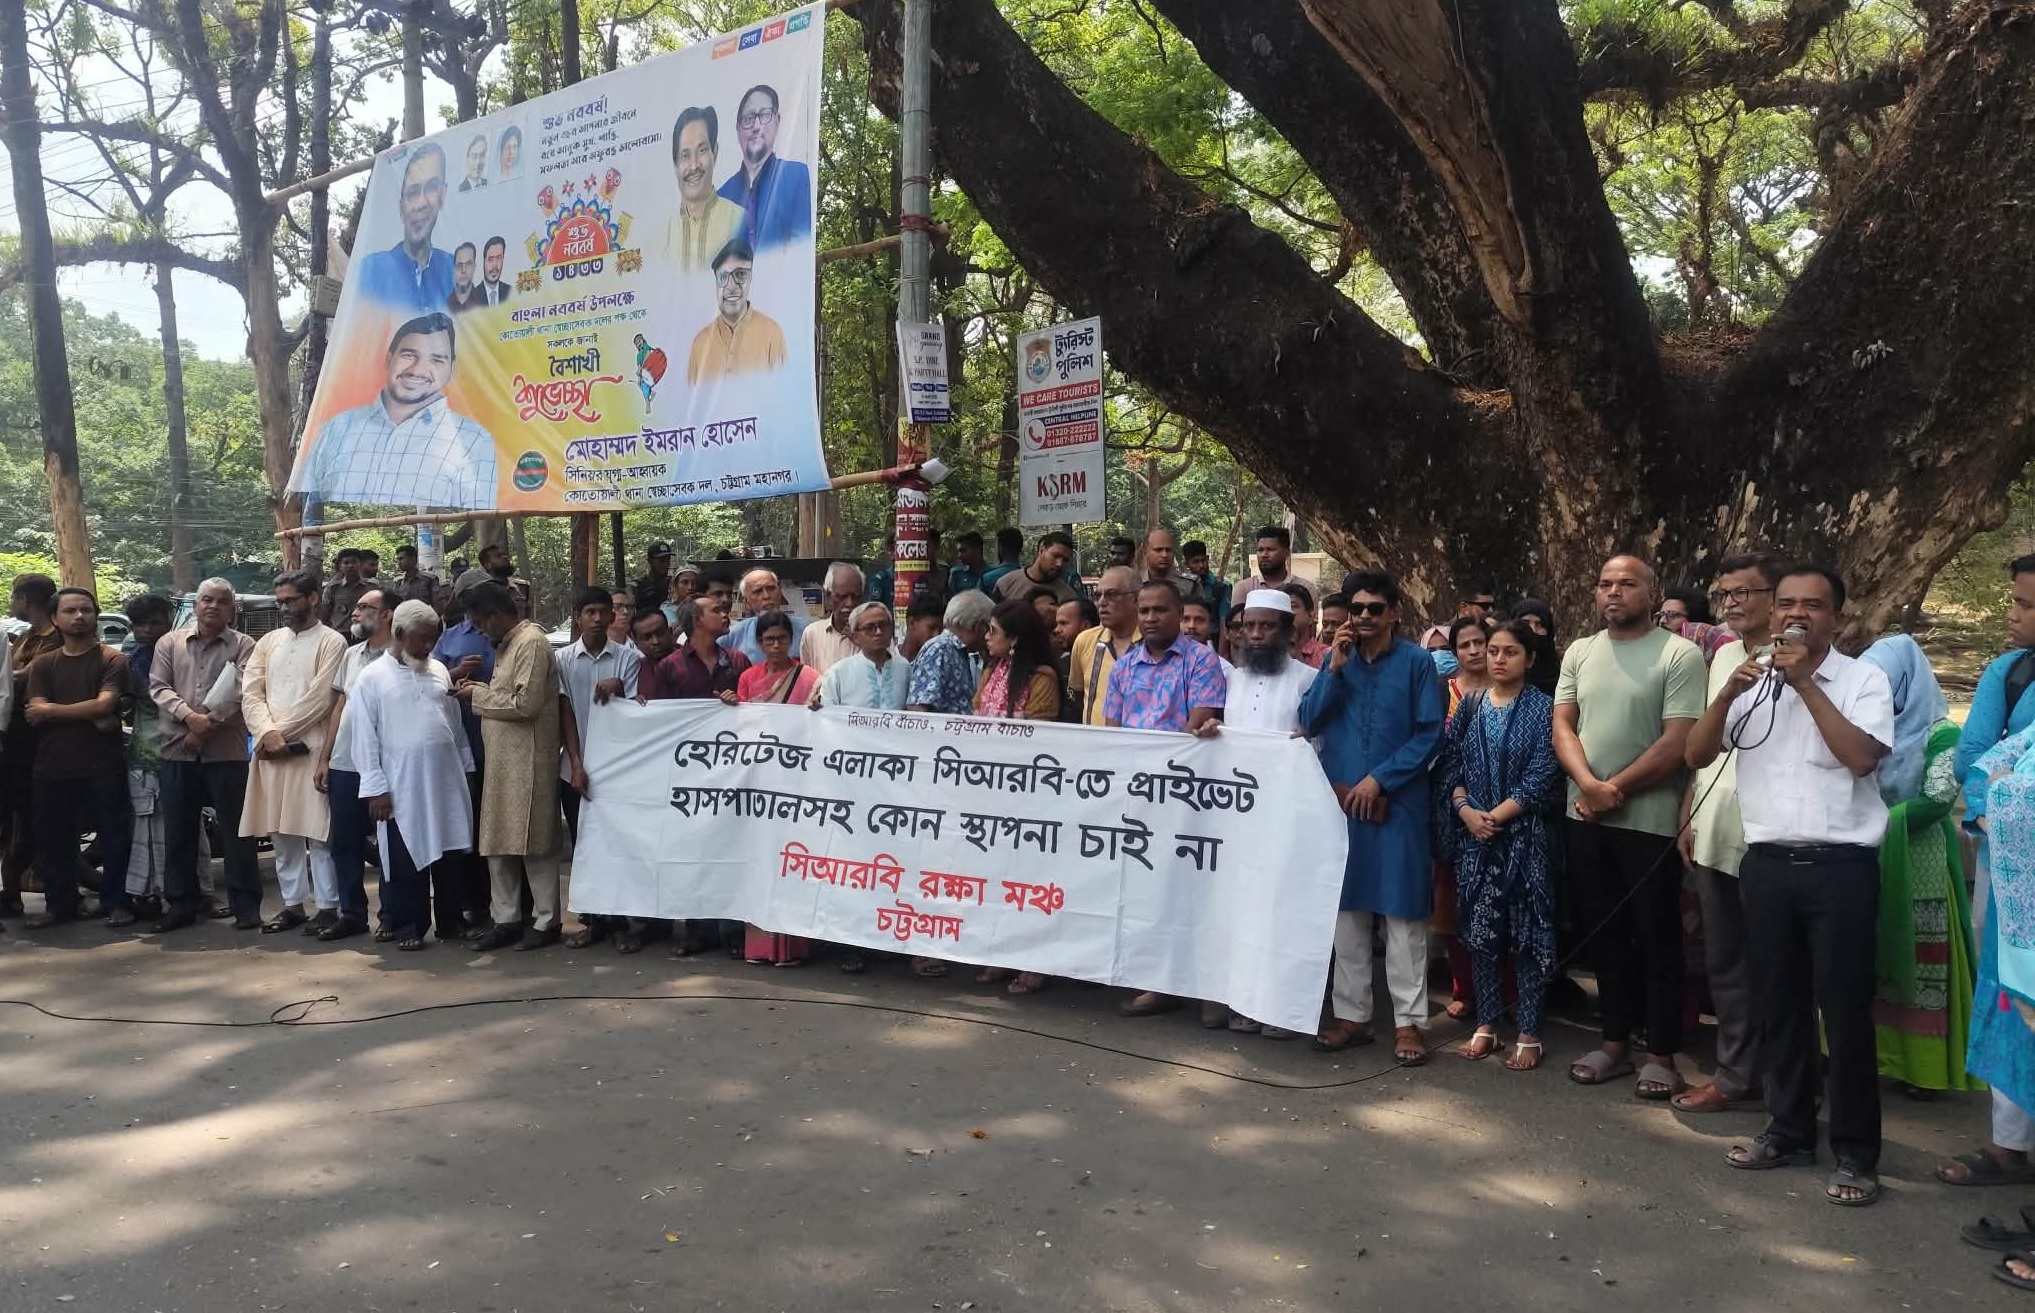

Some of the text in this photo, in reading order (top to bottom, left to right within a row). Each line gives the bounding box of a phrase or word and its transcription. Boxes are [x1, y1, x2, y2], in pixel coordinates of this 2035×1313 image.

[563, 232, 595, 257] নববর্ষ
[567, 223, 590, 240] শুভ
[554, 258, 603, 281] ১৪৩৩
[511, 291, 635, 323] বাংলা নববর্ষ উপলক্ষে
[547, 333, 598, 349] সকলকে জানাই
[1055, 327, 1094, 357] ট্যুরিস্ট
[548, 348, 601, 377] বৈশাখী
[1055, 353, 1094, 379] পুলিশ
[513, 374, 624, 423] শুভেচ্ছা
[1023, 383, 1098, 405] WE CARE TOURISTS
[566, 416, 757, 463] মোহাম্মদ ইমরান হোসেন
[564, 466, 602, 483] সিনিয়র
[564, 486, 622, 502] কোতোয়ালী
[625, 486, 644, 500] থানা
[647, 481, 695, 500] স্বেচ্ছাসেবক
[720, 474, 751, 491] চট্টগ্রাম
[1037, 470, 1087, 500] KSRM
[896, 540, 928, 560] কলেজ
[848, 711, 893, 729] সিআরবি
[674, 730, 1259, 813] হেরিটেজ এলাকা সিআরবি-তে প্রাইভেট
[670, 786, 1223, 871] হাসপাতালসহ কোন স্থাপনা চাই না
[780, 841, 1065, 915] সিআরবি রক্ষা মঞ্চ
[877, 899, 963, 942] চট্টগ্রাম
